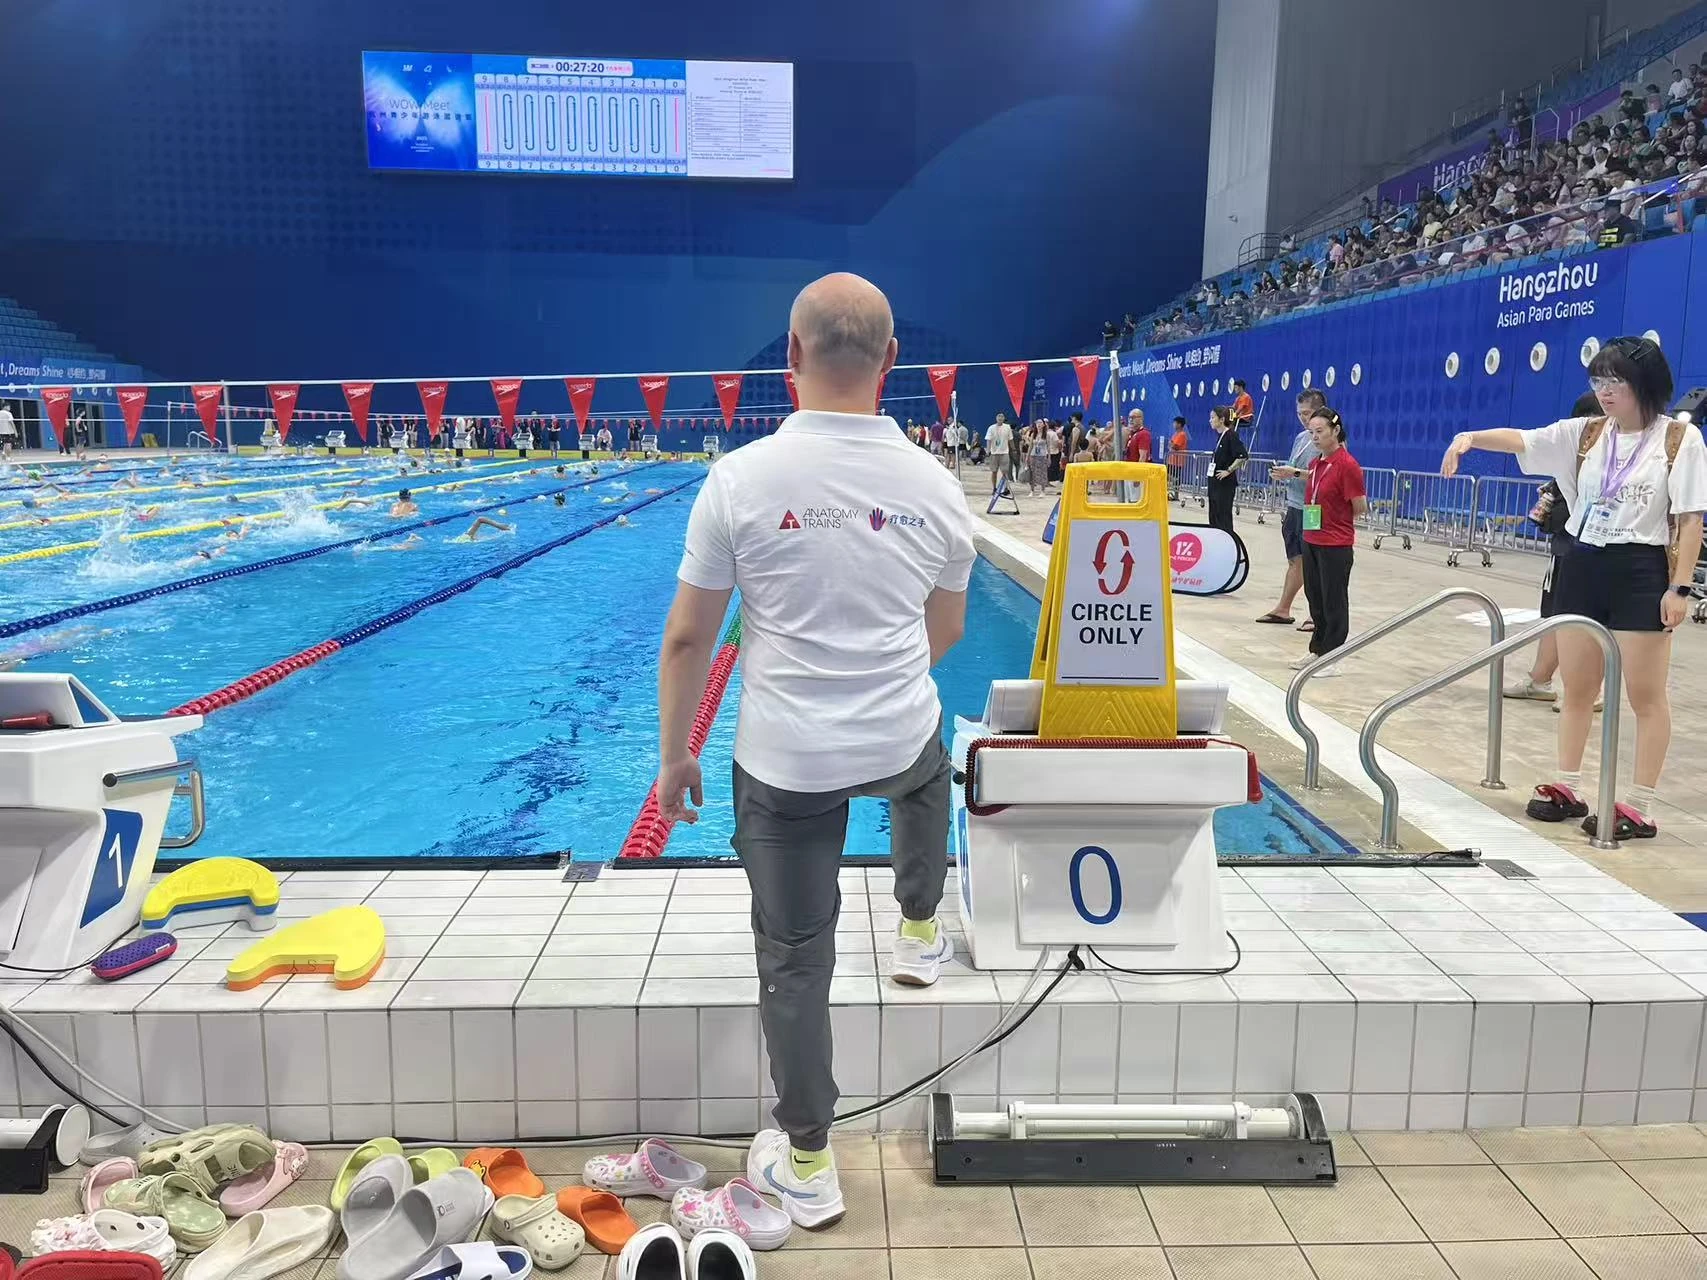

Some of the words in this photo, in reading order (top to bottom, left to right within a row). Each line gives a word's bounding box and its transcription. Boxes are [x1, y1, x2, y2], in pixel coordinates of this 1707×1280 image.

[555, 61, 605, 73] 00:27:20
[390, 100, 418, 110] WOW
[1500, 262, 1598, 303] Hangzhou
[1496, 309, 1526, 328] Asian
[1528, 306, 1552, 323] Para
[1555, 300, 1594, 319] Games
[1166, 352, 1182, 371] Shine
[8, 365, 40, 377] Dreams
[41, 365, 64, 378] Shine
[803, 508, 859, 519] ANATOMY
[803, 519, 841, 529] TRAINS
[1176, 541, 1194, 556] 1%
[1071, 603, 1152, 621] CIRCLE
[1079, 627, 1144, 645] ONLY
[108, 833, 123, 888] 1
[1069, 846, 1122, 925] 0
